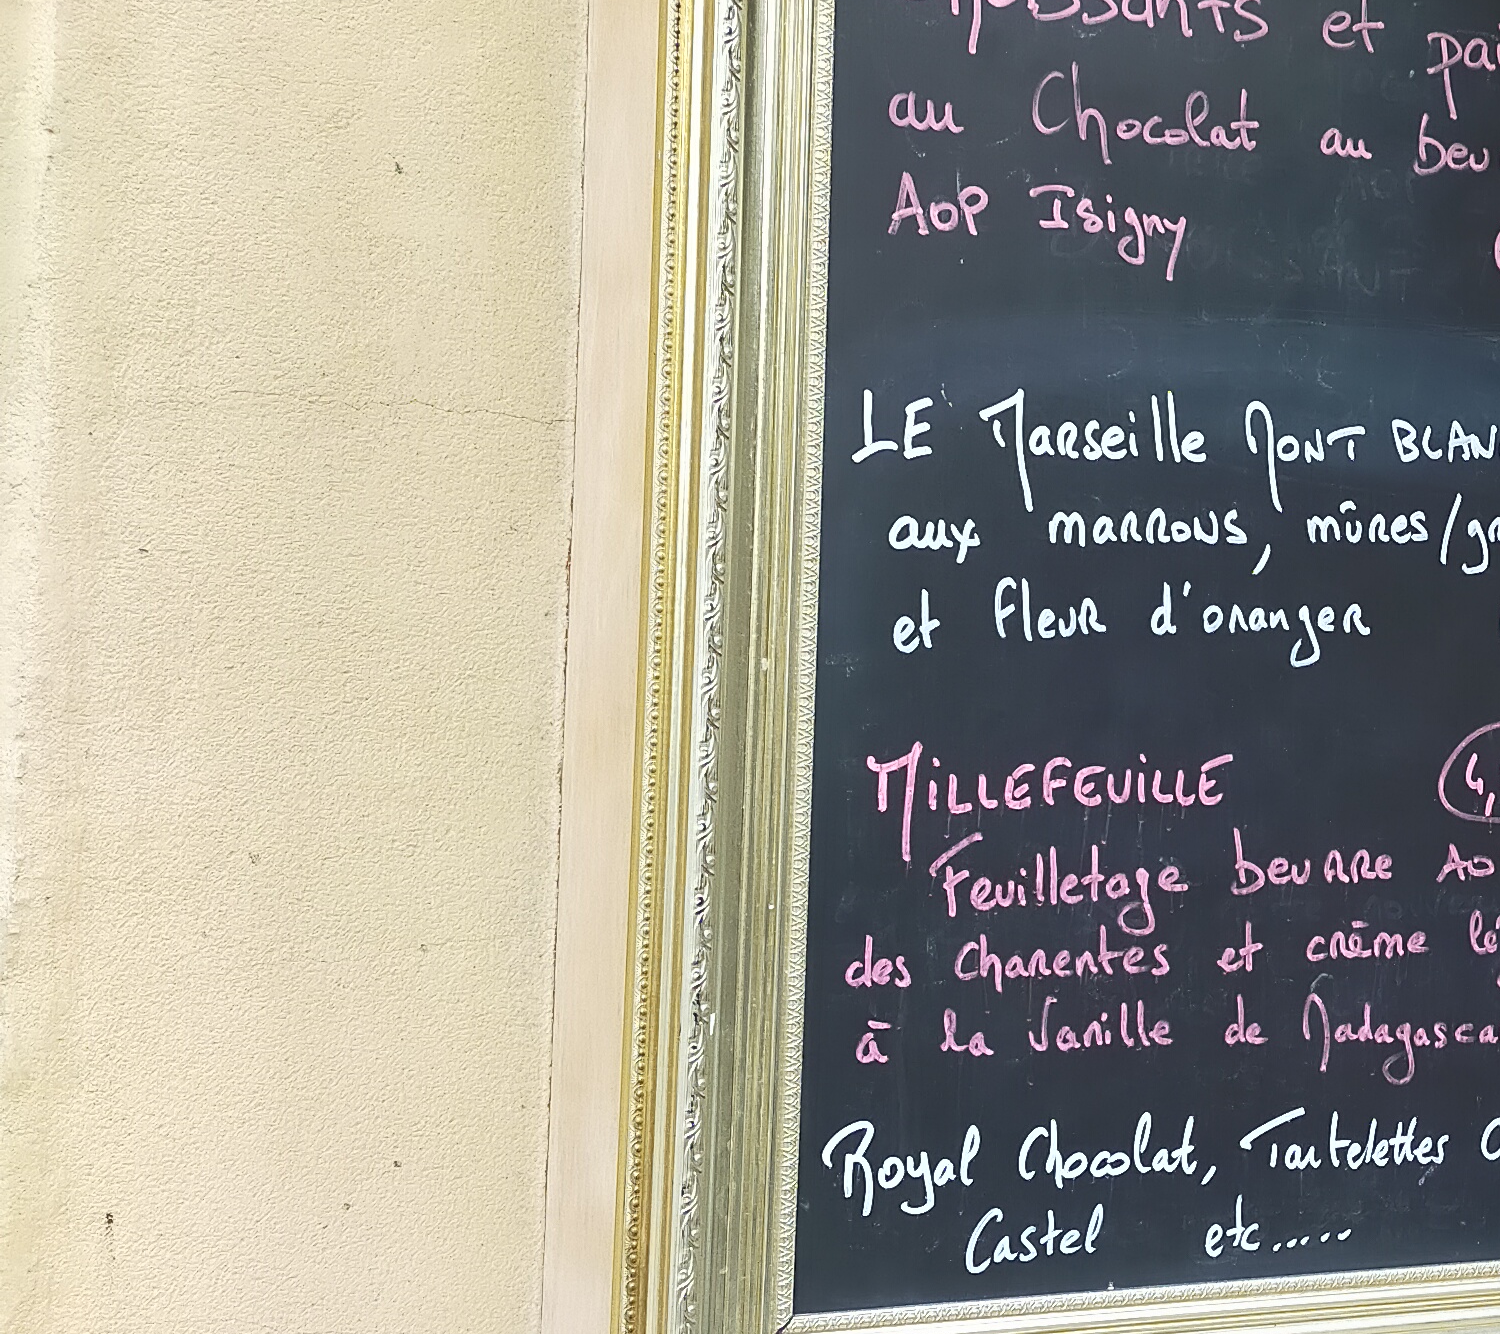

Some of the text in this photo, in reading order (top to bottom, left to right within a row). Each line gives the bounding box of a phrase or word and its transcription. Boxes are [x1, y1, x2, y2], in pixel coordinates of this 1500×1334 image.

[888, 90, 964, 133] au
[1031, 62, 1260, 165] Chocolat
[1320, 127, 1373, 160] au
[1028, 184, 1187, 281] Isigny
[851, 388, 934, 464] LE
[979, 387, 1208, 513] Marseille
[888, 514, 982, 564] aux
[892, 588, 941, 654] et
[928, 831, 1189, 936] Feuilletage
[844, 935, 912, 988] des
[954, 936, 1171, 993] Charentes
[1216, 920, 1264, 973] et
[939, 1007, 995, 1058] la
[1224, 994, 1269, 1046] de
[821, 1120, 981, 1217] Royal
[1018, 1111, 1218, 1187] Chocolat,
[1239, 1107, 1447, 1171] Tartelettes
[965, 1205, 1105, 1274] Castel
